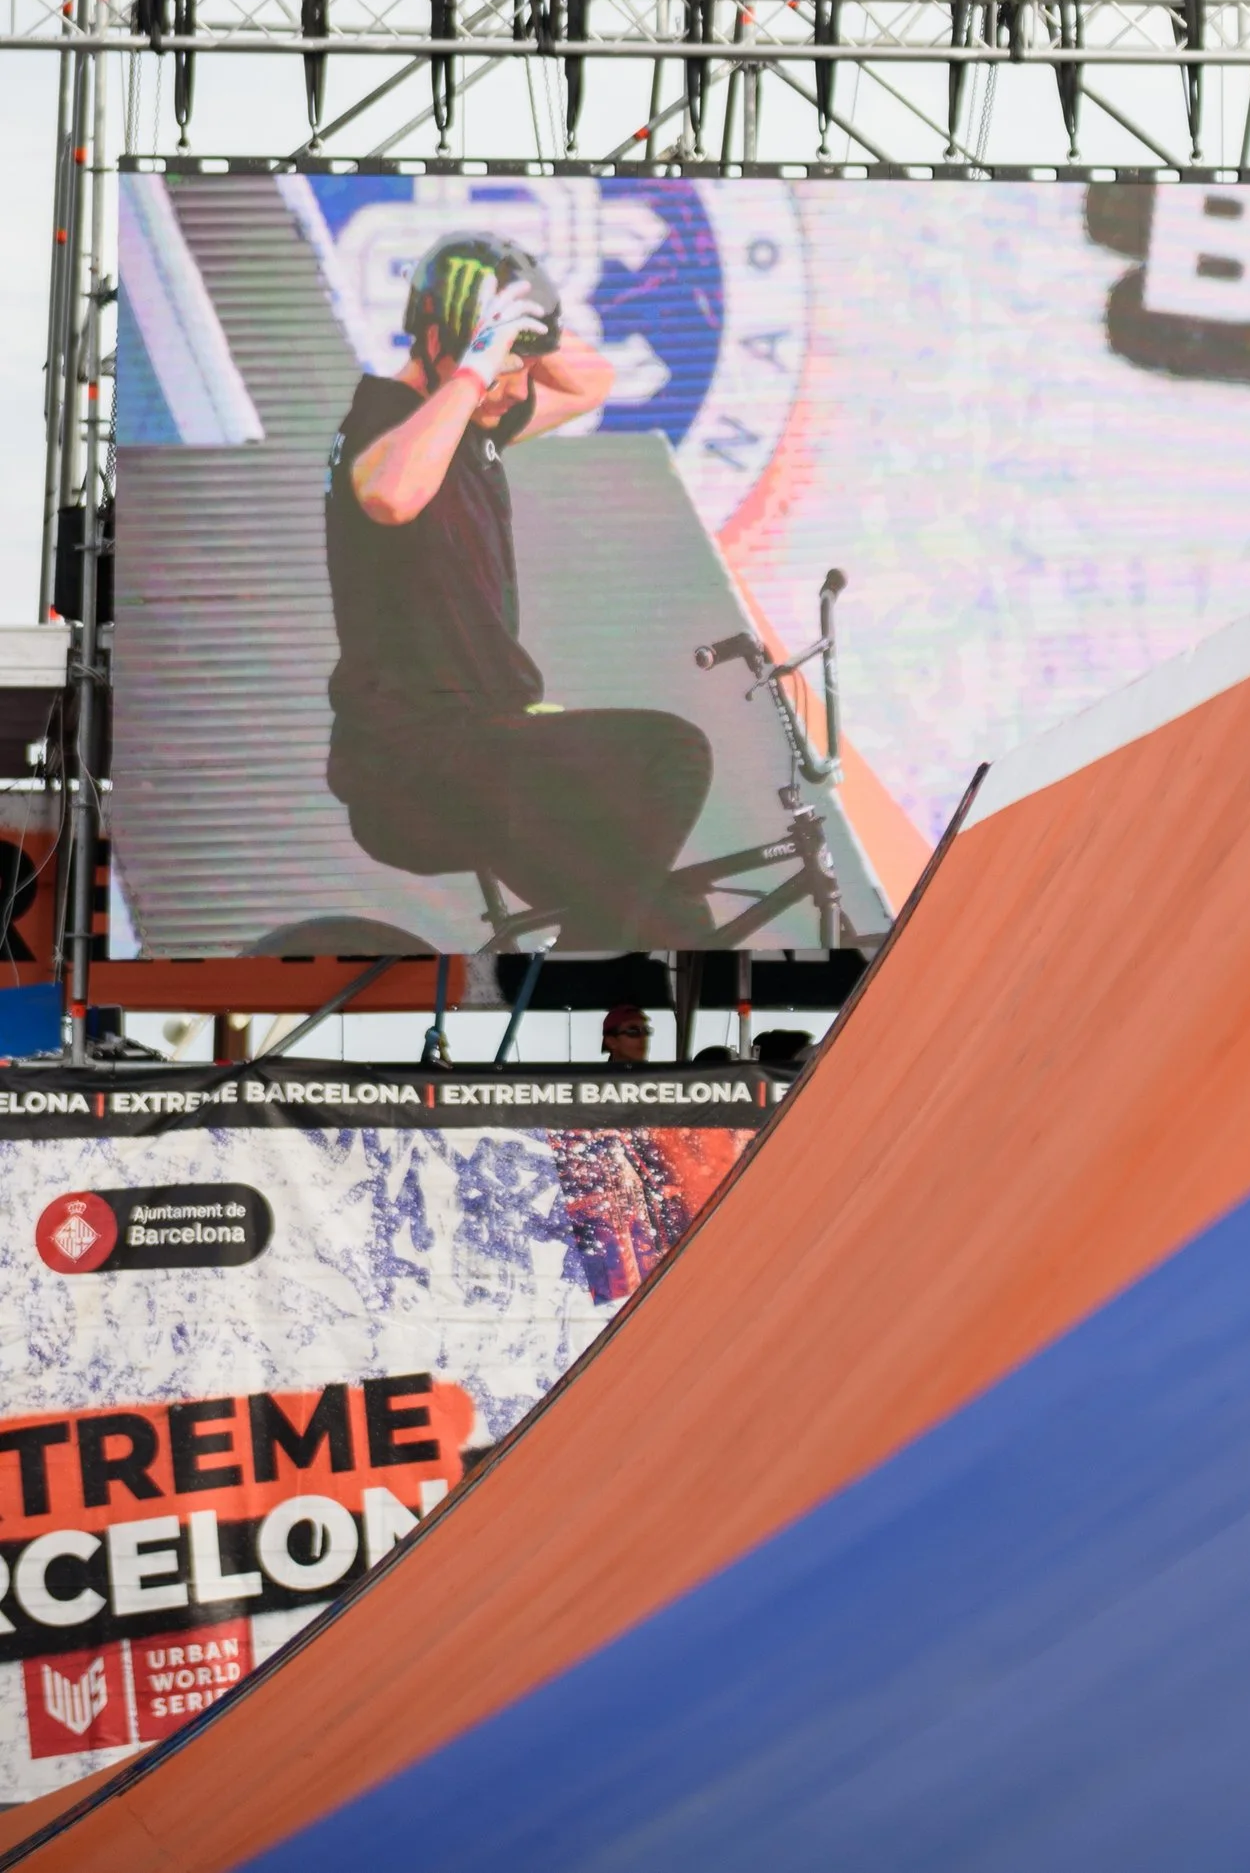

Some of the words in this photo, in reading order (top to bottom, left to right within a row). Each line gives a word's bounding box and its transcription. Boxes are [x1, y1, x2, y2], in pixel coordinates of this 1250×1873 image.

[112, 1081, 238, 1113] EXTREME
[245, 1080, 421, 1104] BARCELONA
[442, 1083, 573, 1105] EXTREME
[580, 1081, 752, 1105] BARCELONA
[130, 1203, 223, 1224] Ajuntament
[225, 1201, 246, 1218] de
[127, 1222, 246, 1246] Barcelona
[0, 1372, 440, 1521] TREME
[147, 1637, 239, 1669] URBAN
[149, 1662, 241, 1693] WORLD
